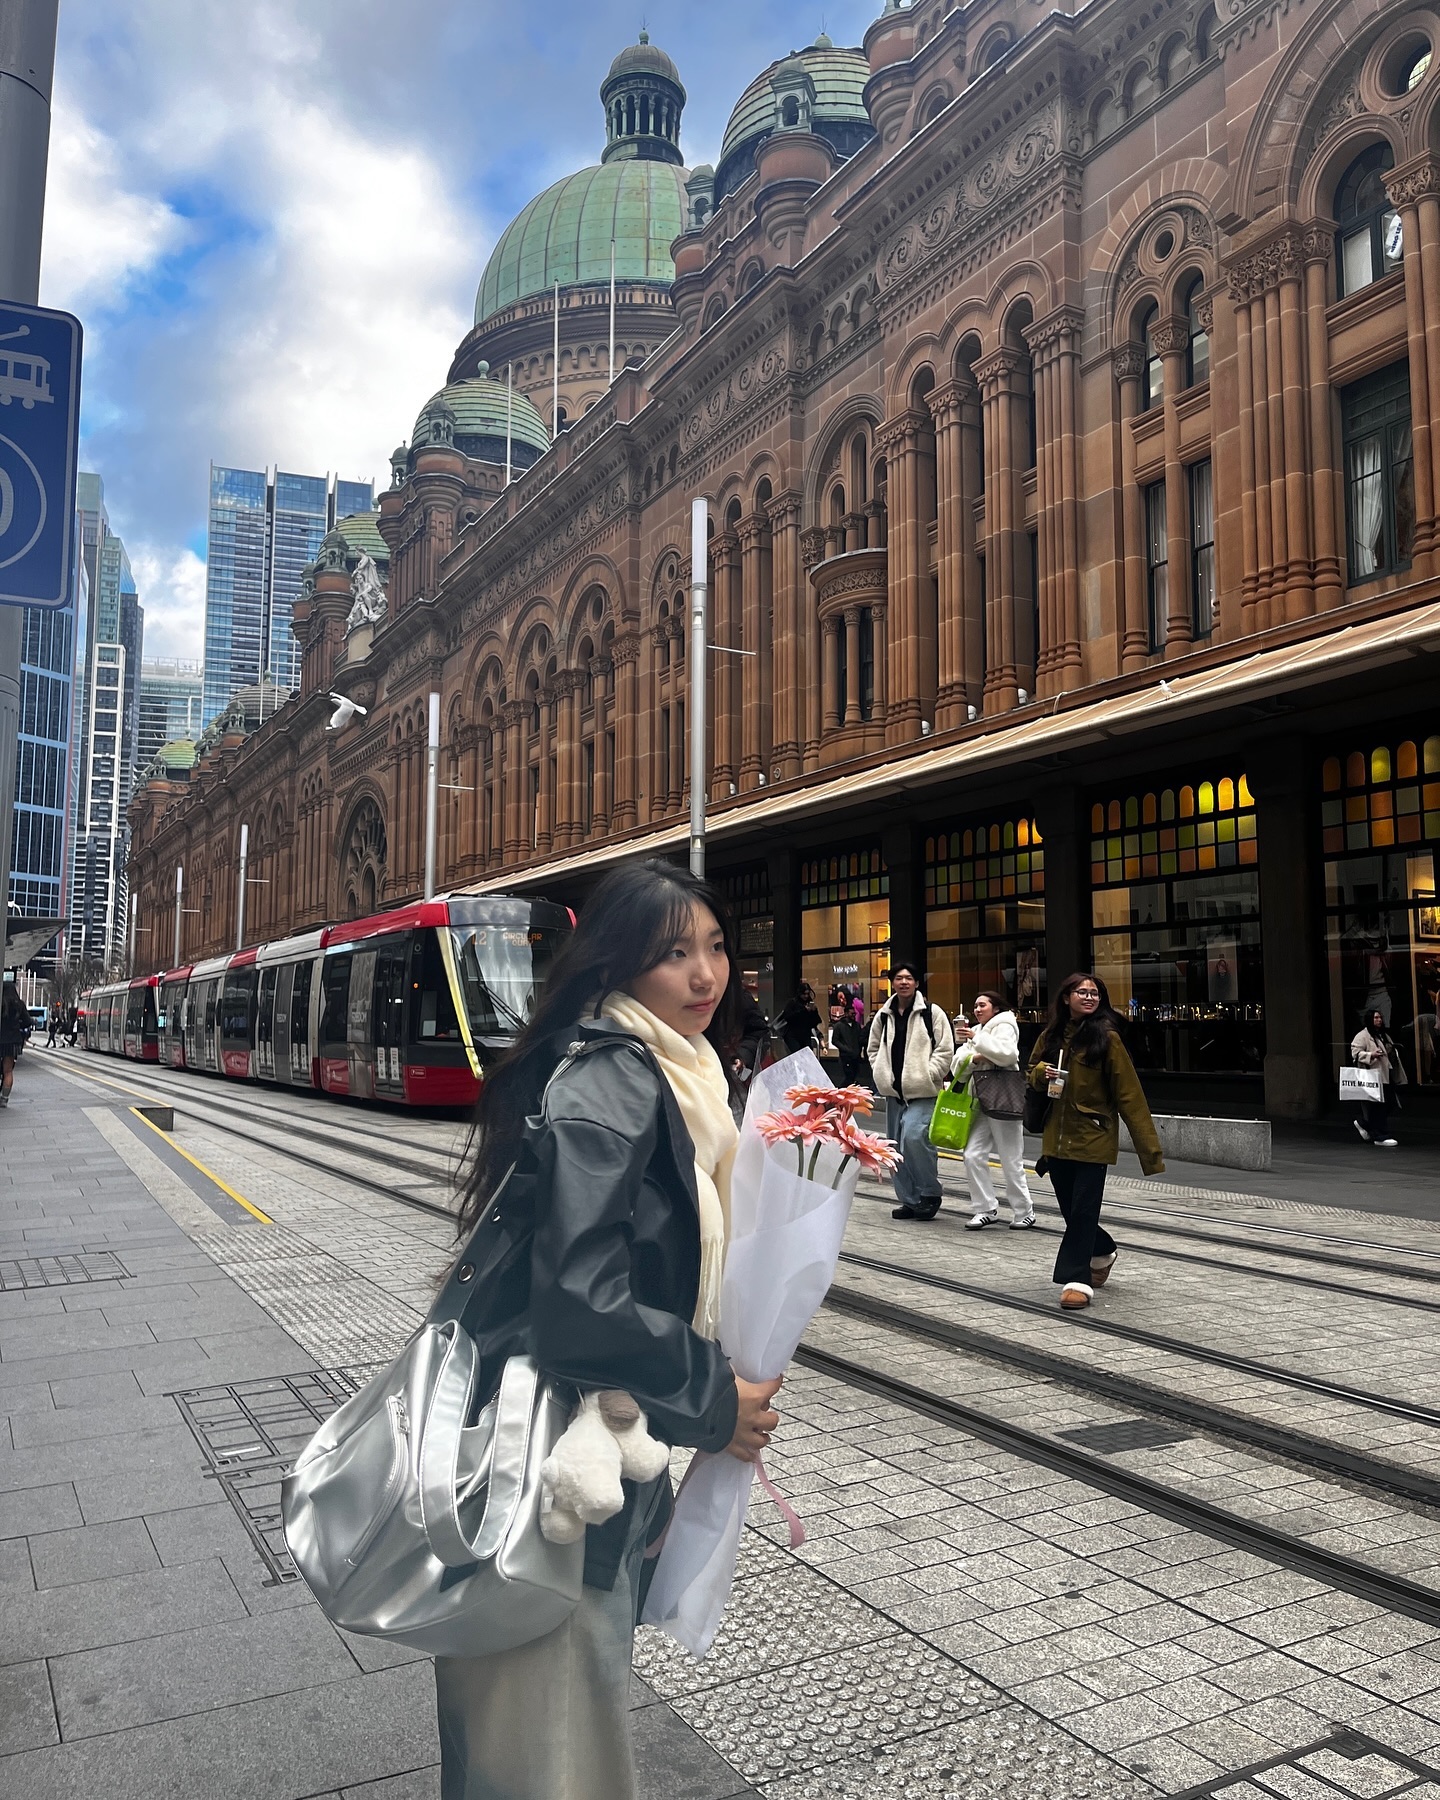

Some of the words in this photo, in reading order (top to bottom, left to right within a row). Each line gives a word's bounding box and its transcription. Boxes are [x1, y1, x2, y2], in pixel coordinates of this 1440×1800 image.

[472, 930, 487, 946] L2
[502, 932, 543, 941] CIRCULAR
[1357, 1080, 1379, 1088] MADDEN
[940, 1107, 967, 1118] crocs
